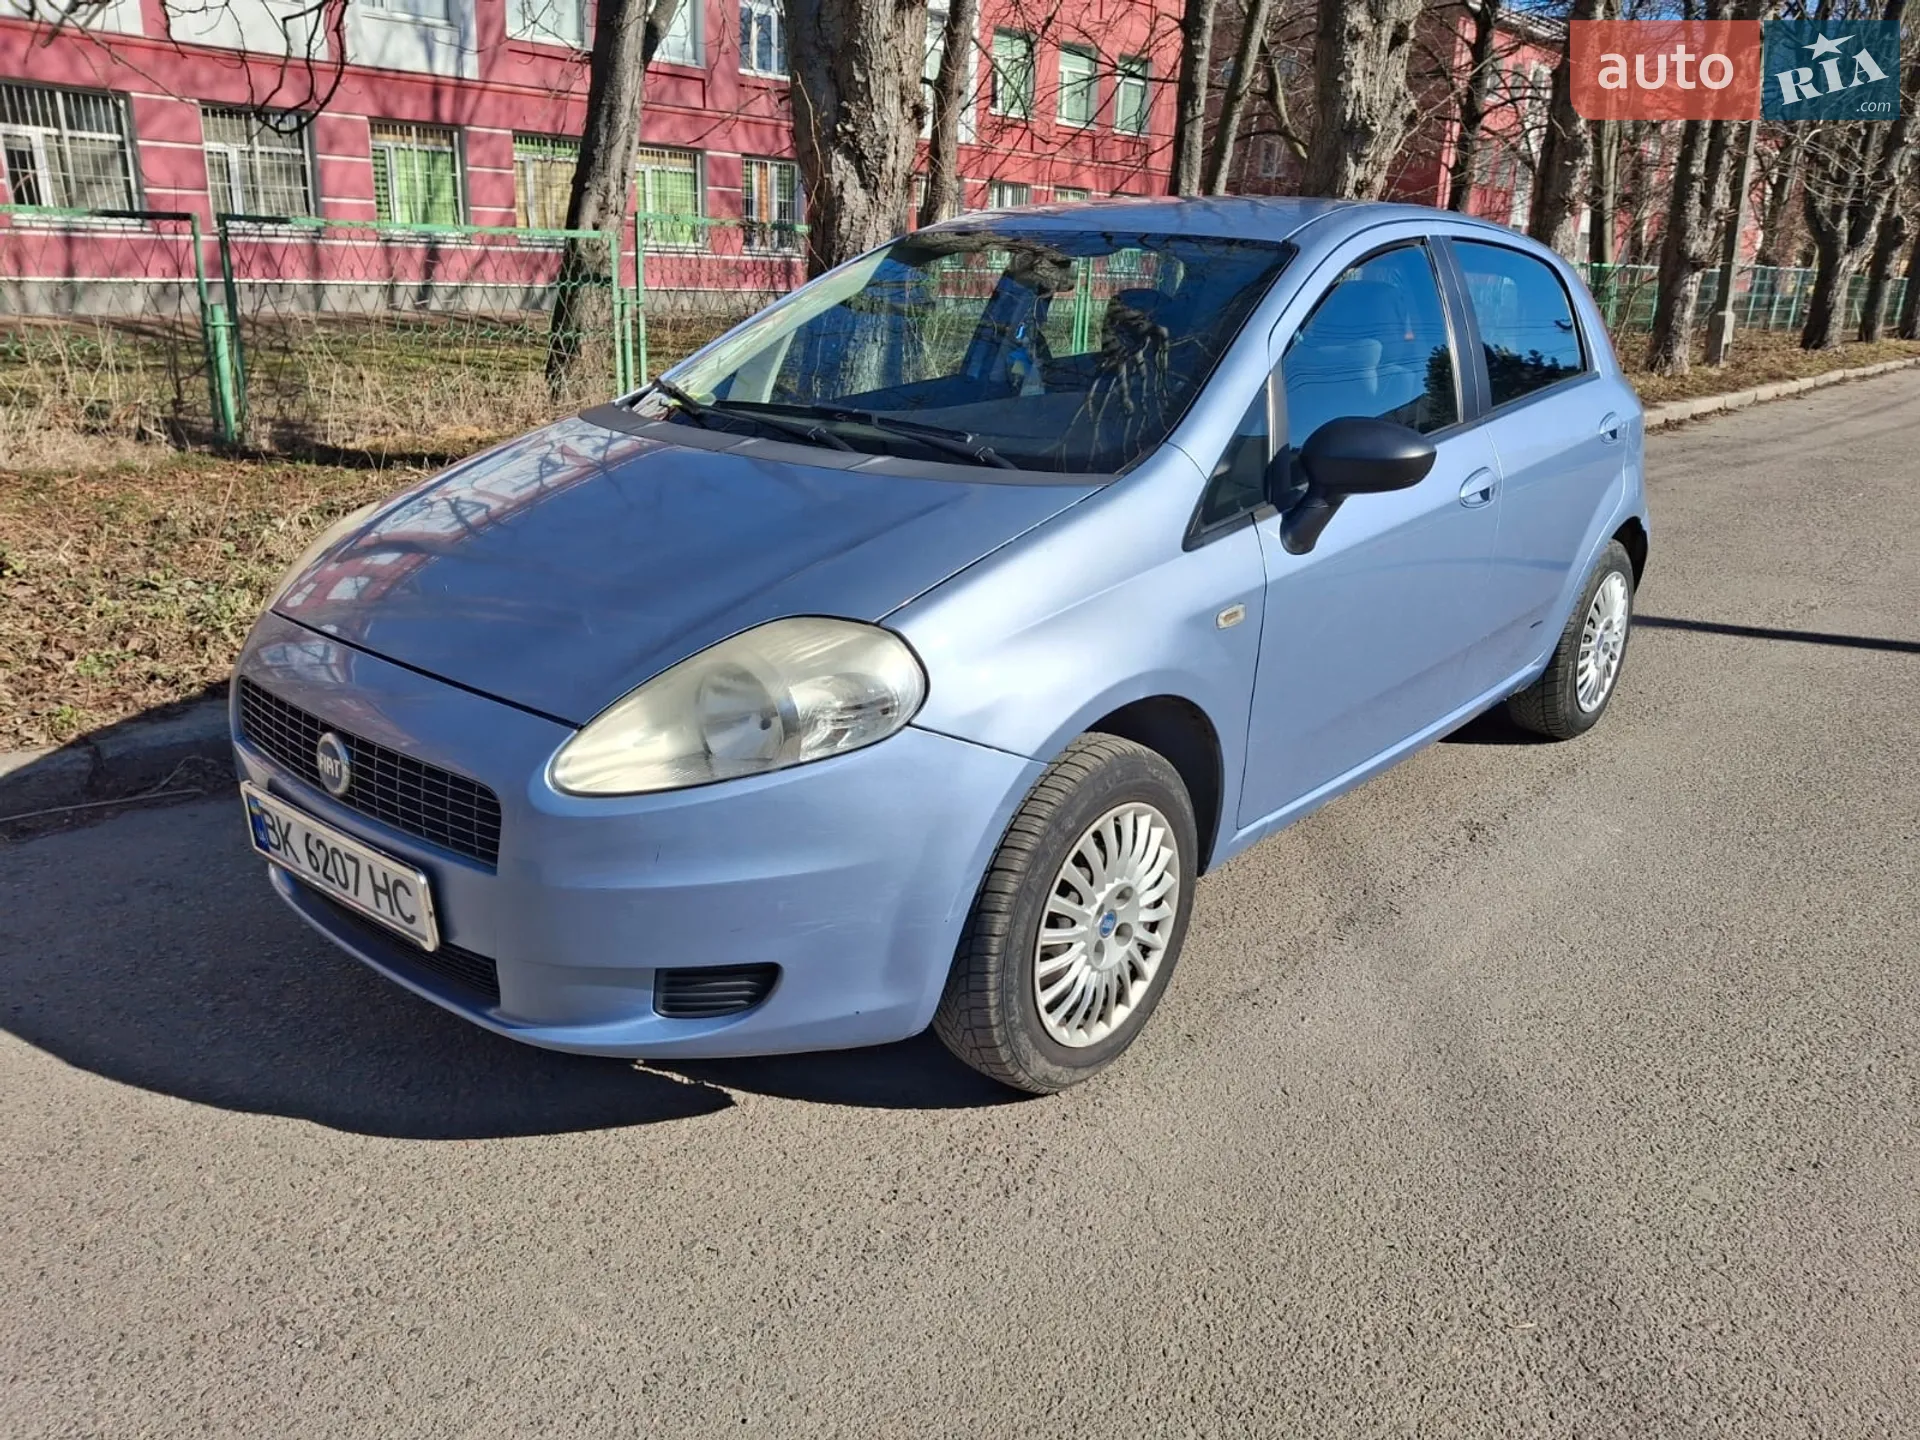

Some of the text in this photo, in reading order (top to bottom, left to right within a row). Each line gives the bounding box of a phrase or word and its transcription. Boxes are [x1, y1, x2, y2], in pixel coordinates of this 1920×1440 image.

[319, 751, 341, 778] FIAT
[260, 807, 416, 925] BK 6207 HC
